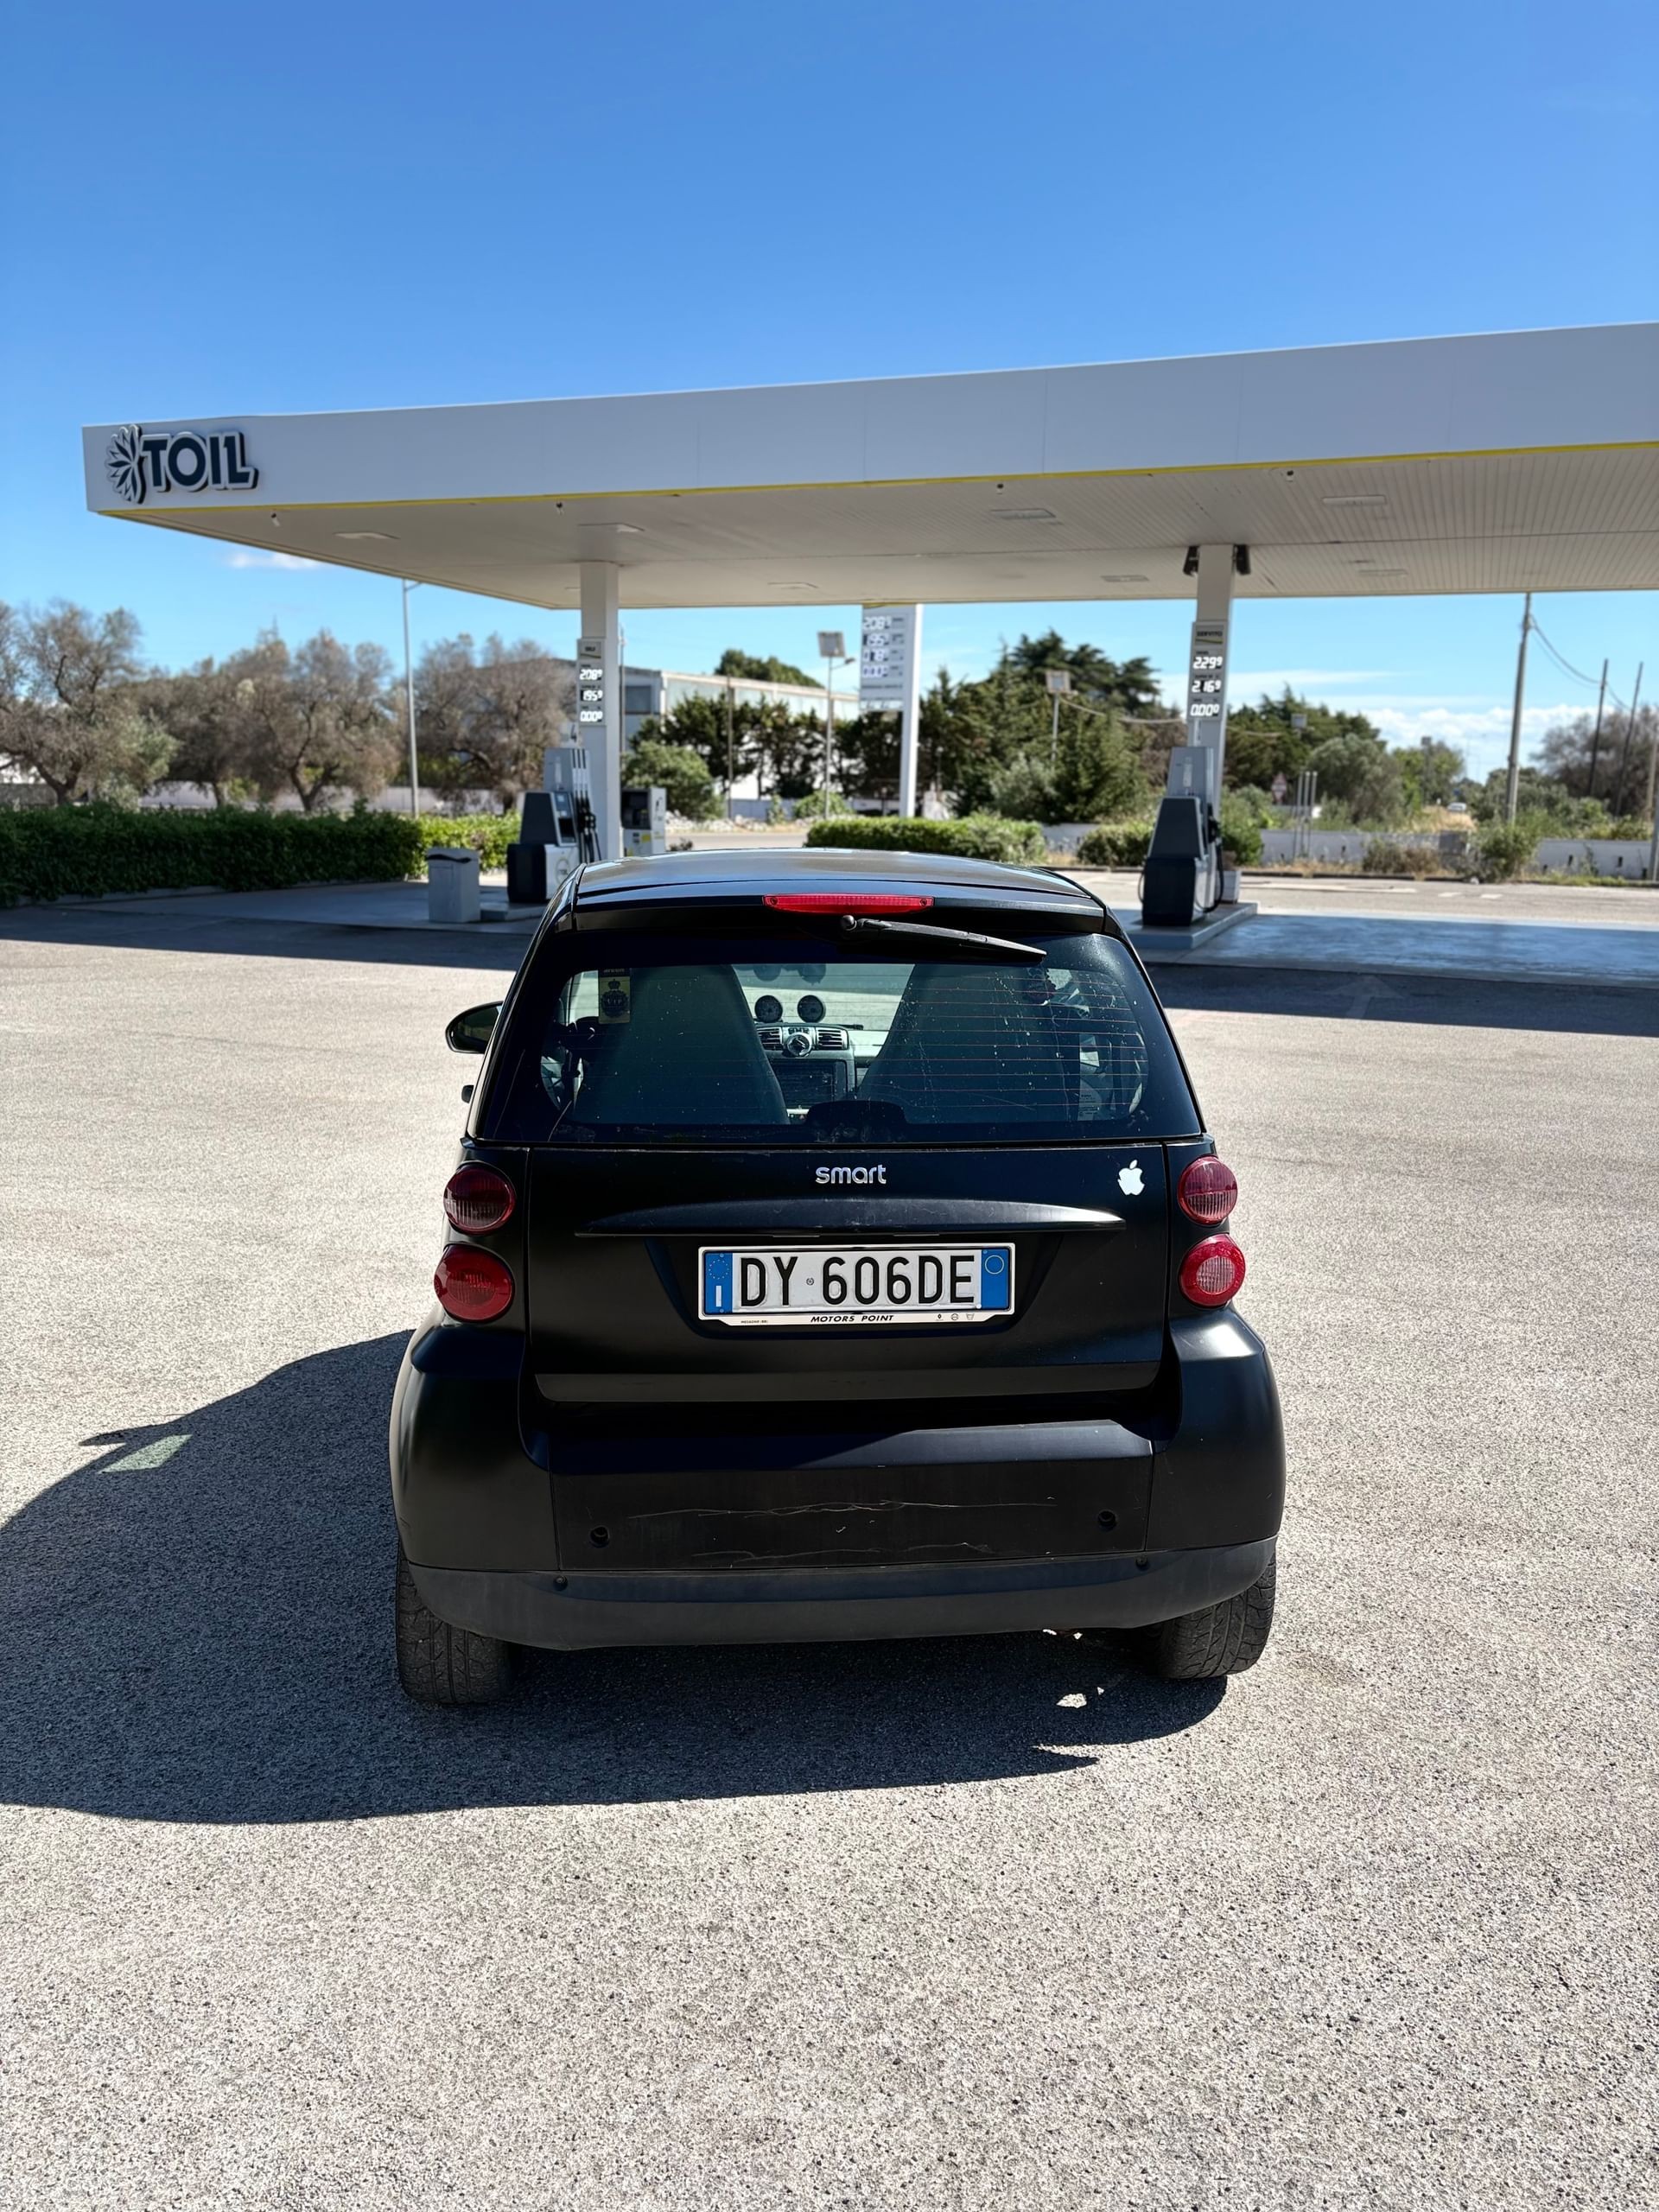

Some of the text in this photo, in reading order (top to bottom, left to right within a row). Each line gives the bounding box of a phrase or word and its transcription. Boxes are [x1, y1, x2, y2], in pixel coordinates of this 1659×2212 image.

[141, 434, 253, 488] TOIL
[816, 1165, 887, 1185] smart
[715, 1285, 722, 1307] I
[741, 1255, 975, 1306] DY 606DE
